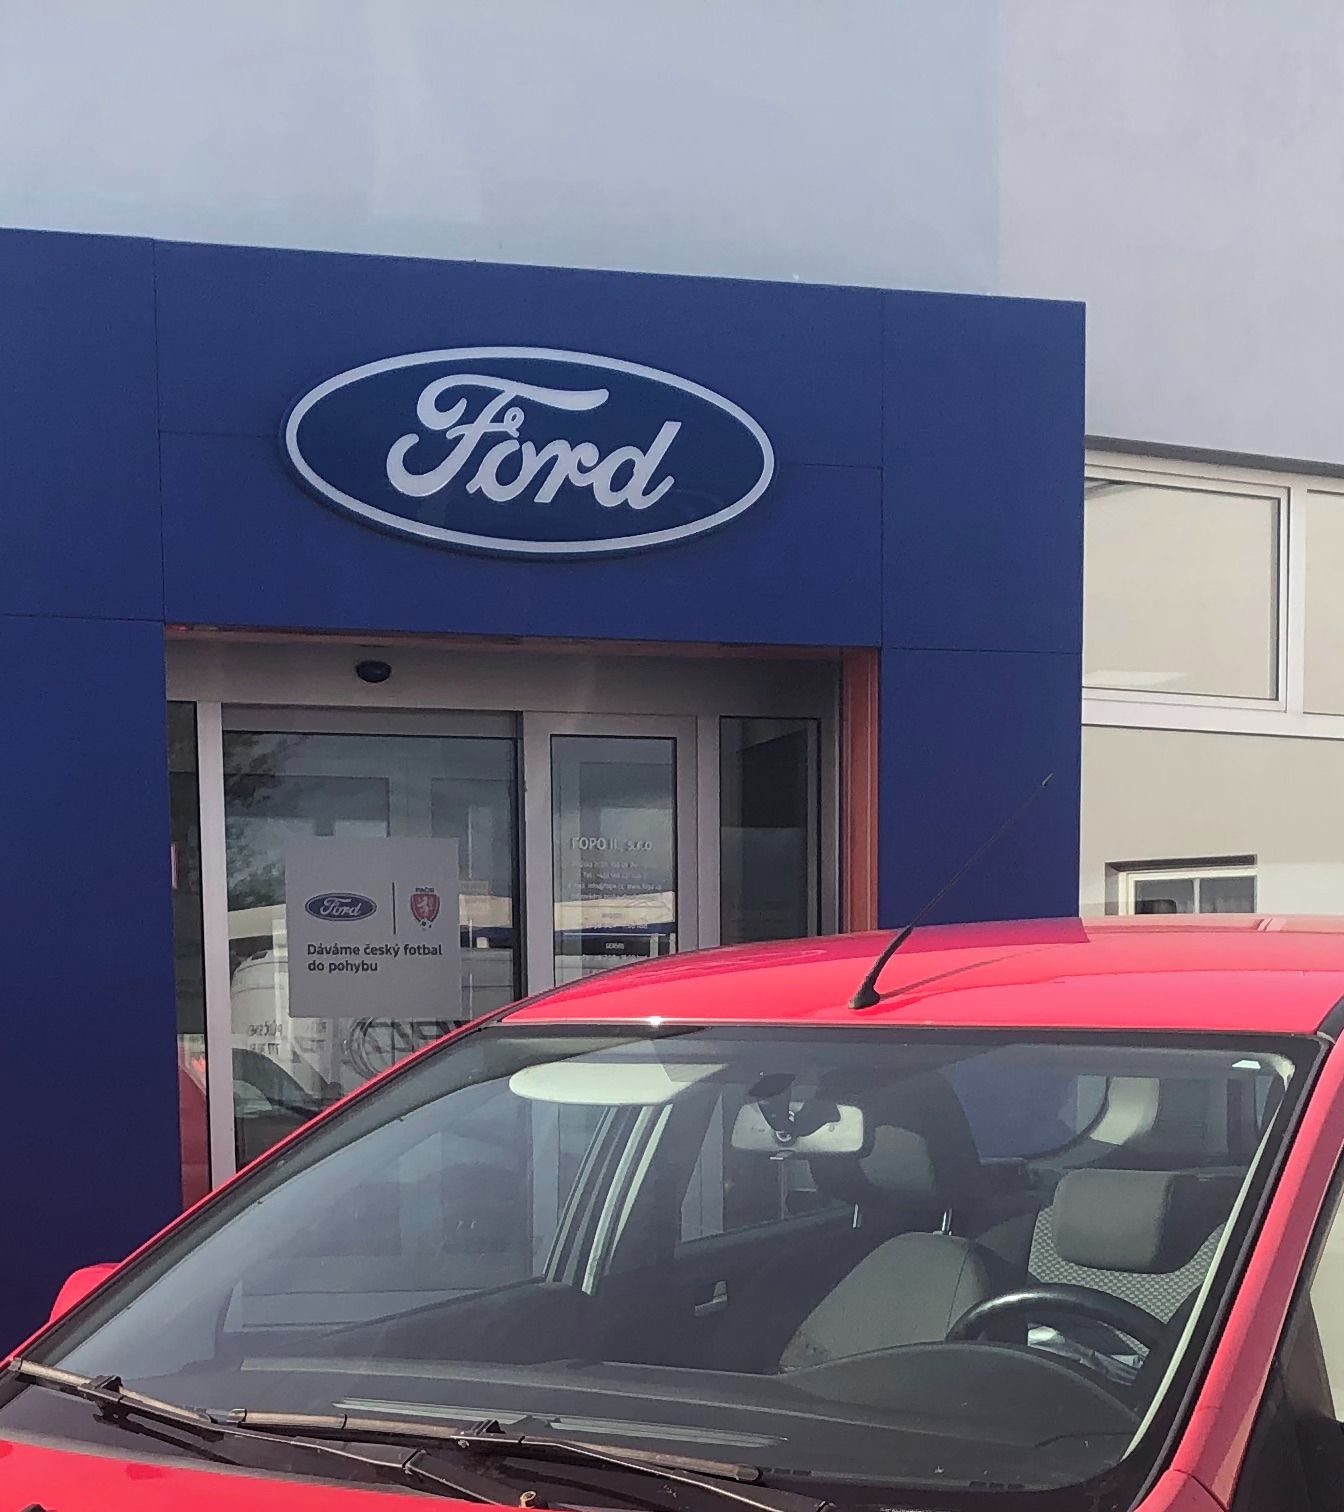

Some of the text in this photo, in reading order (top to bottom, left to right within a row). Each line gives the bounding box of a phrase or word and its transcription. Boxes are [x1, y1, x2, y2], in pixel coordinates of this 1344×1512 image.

[387, 374, 682, 510] Ford
[319, 897, 362, 916] Ford
[306, 942, 443, 958] Dáváme český fotbal
[307, 959, 378, 974] do pohybu
